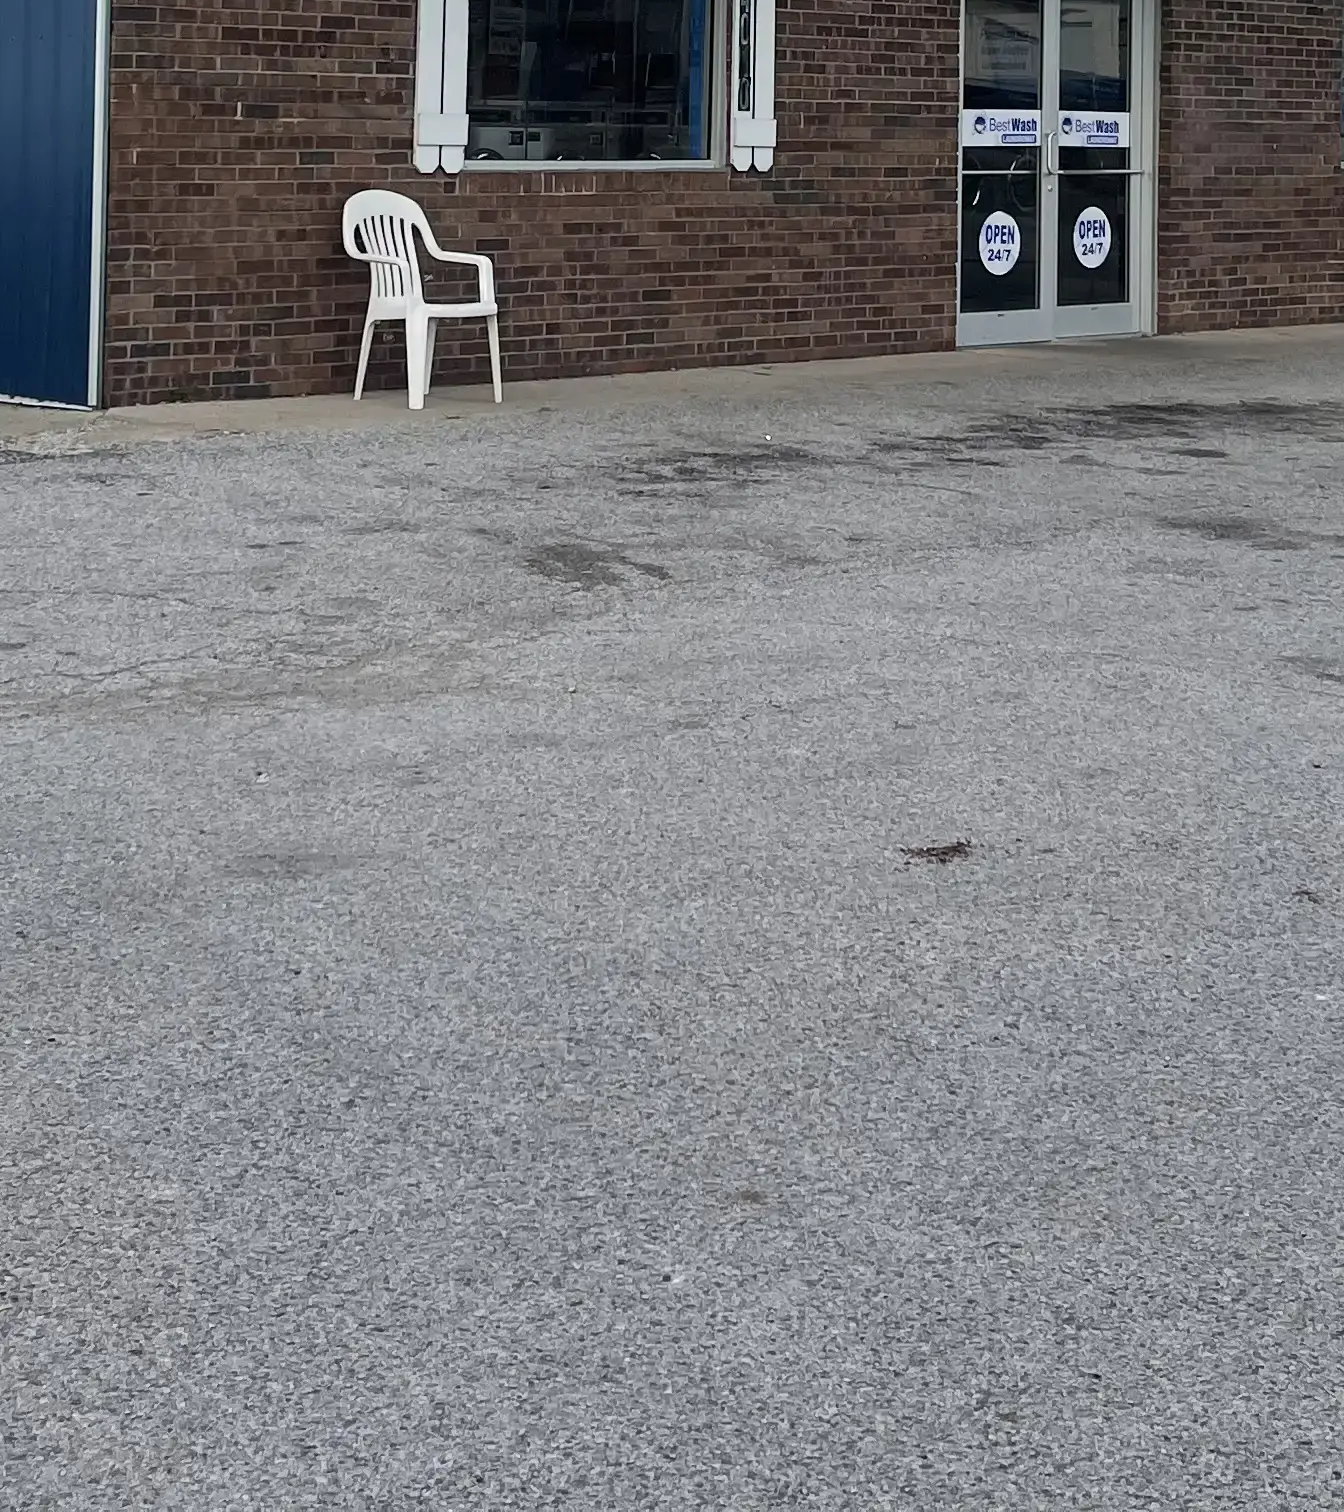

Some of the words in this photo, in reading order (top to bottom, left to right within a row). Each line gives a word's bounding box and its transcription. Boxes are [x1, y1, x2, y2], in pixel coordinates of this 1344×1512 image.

[985, 224, 1015, 245] OPEN
[1078, 219, 1106, 240] OPEN
[987, 248, 1011, 262] 24/7
[1081, 242, 1104, 256] 24/7
